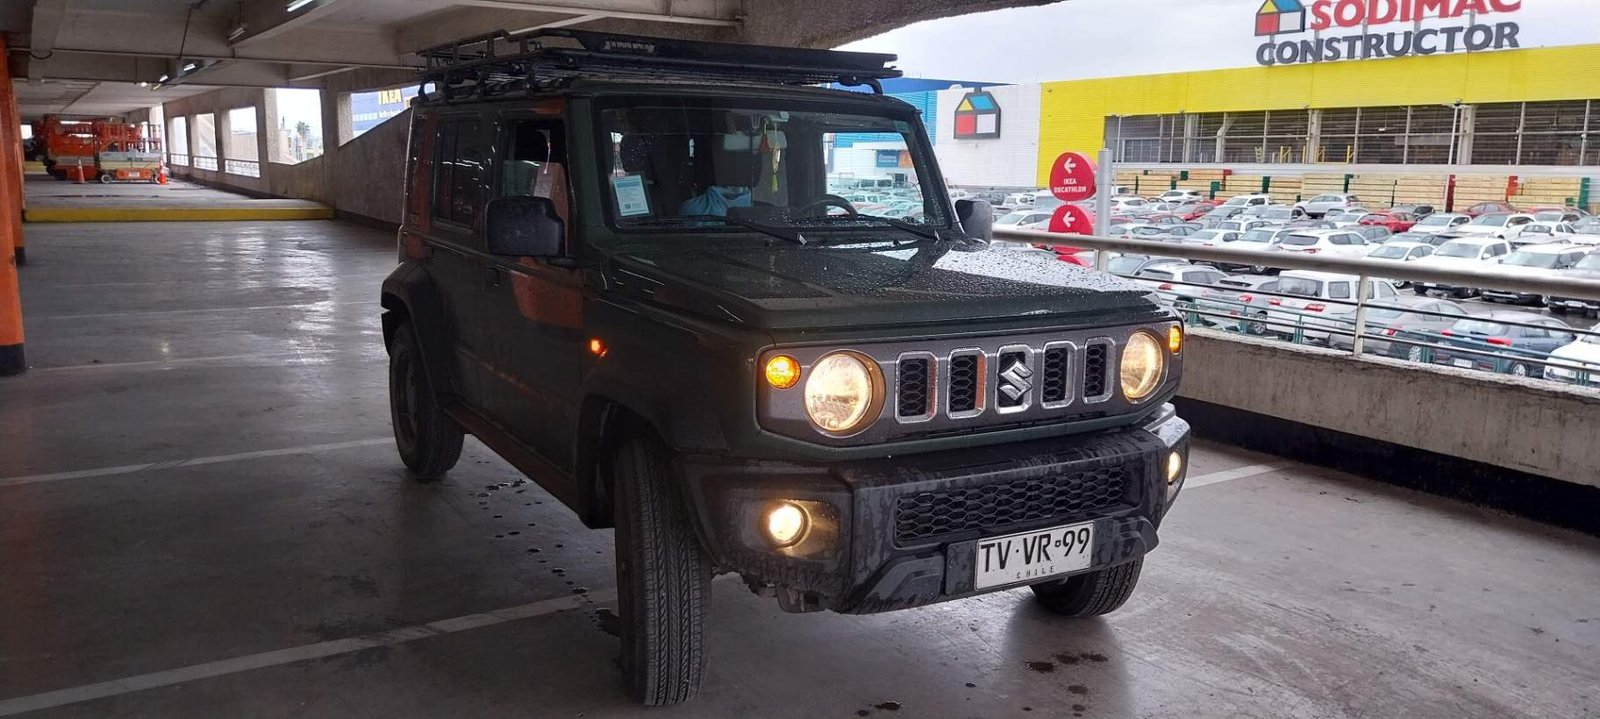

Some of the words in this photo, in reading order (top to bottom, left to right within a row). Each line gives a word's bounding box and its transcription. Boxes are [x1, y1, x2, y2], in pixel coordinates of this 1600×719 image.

[1256, 21, 1520, 67] CONSTRUCTOR
[1053, 186, 1087, 194] DECATHLON
[1016, 565, 1055, 579] CHILE
